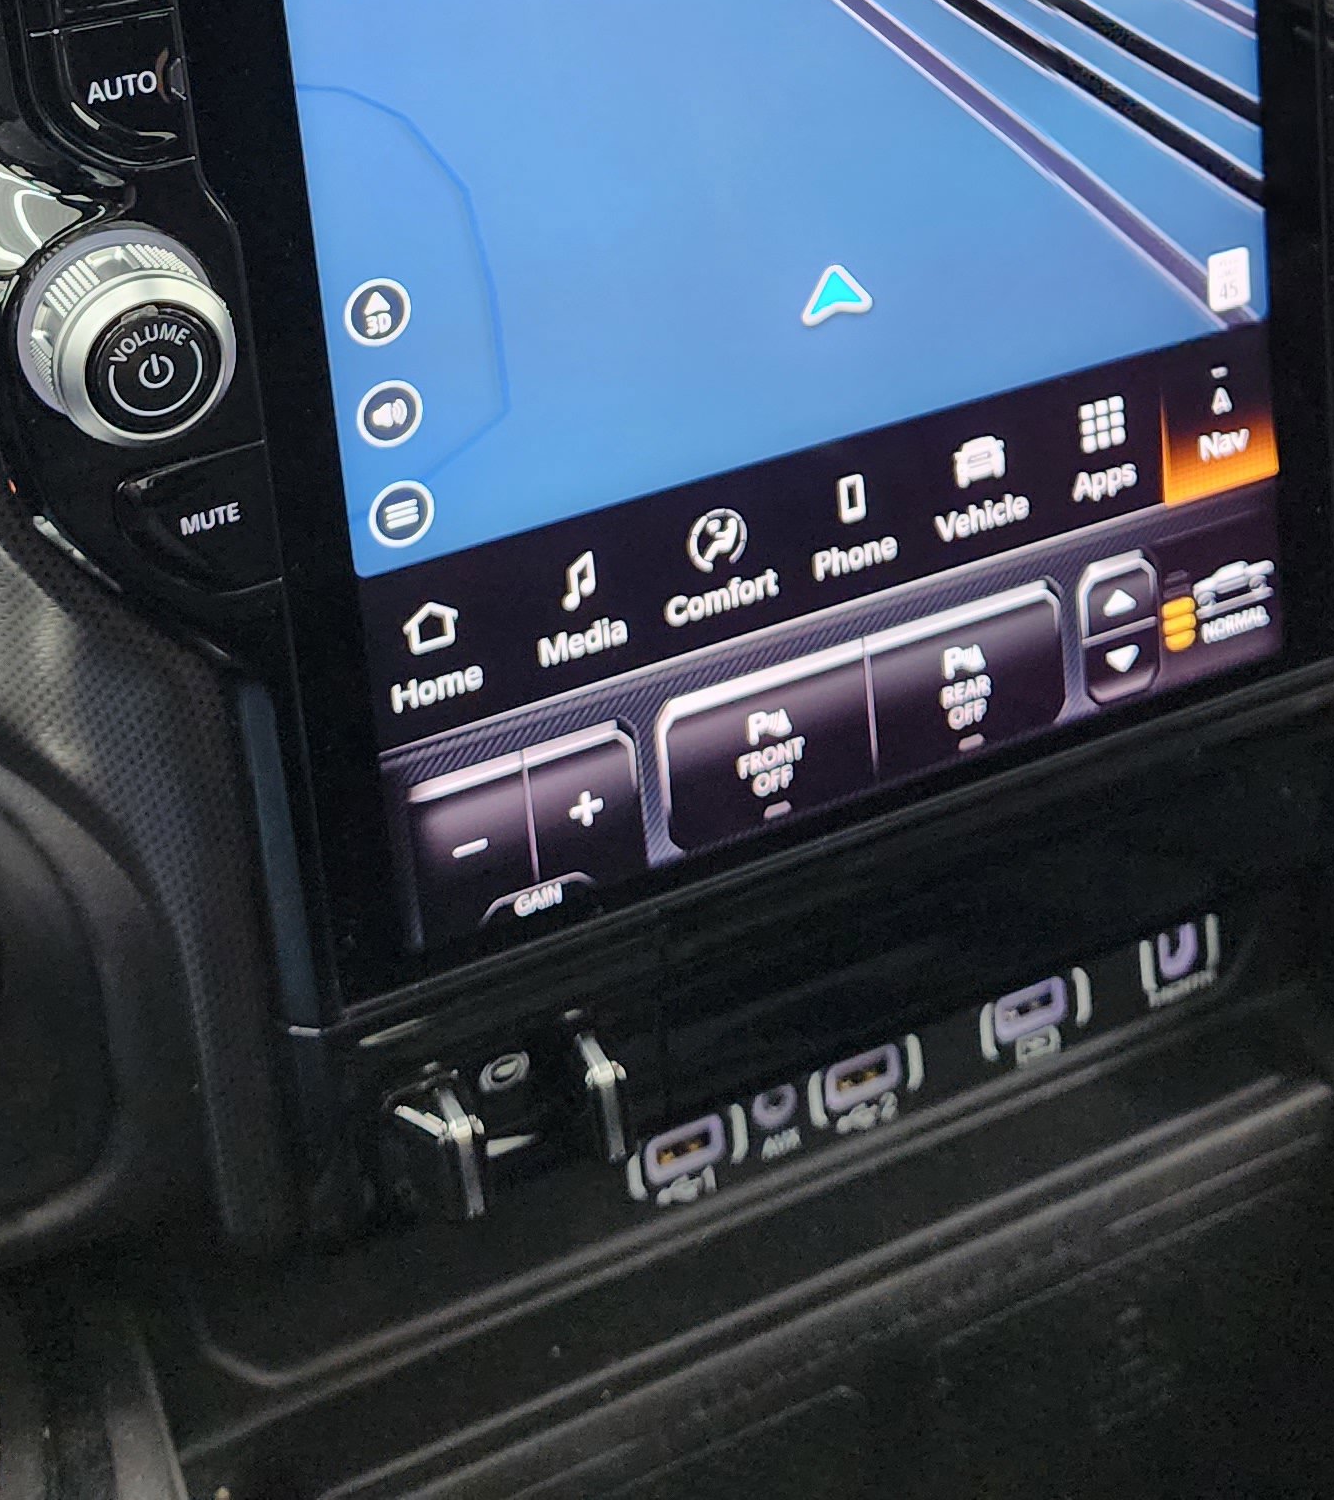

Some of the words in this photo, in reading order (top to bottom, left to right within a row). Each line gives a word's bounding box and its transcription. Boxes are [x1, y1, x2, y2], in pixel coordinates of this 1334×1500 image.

[87, 70, 158, 104] AUTO
[109, 322, 192, 364] VOLUME
[366, 312, 392, 336] 3D
[1198, 427, 1250, 461] Nav
[1072, 461, 1138, 502] Apps
[180, 502, 241, 536] MUTE
[934, 493, 1030, 543] Vehicle
[811, 535, 899, 582] Phone
[663, 568, 780, 629] Comfort
[536, 616, 629, 668] Media
[390, 664, 484, 714] Home
[940, 672, 993, 706] REAR
[946, 697, 989, 731] OFF
[735, 735, 806, 780] FRONT
[750, 763, 795, 798] OFF
[513, 881, 564, 918] GAIN
